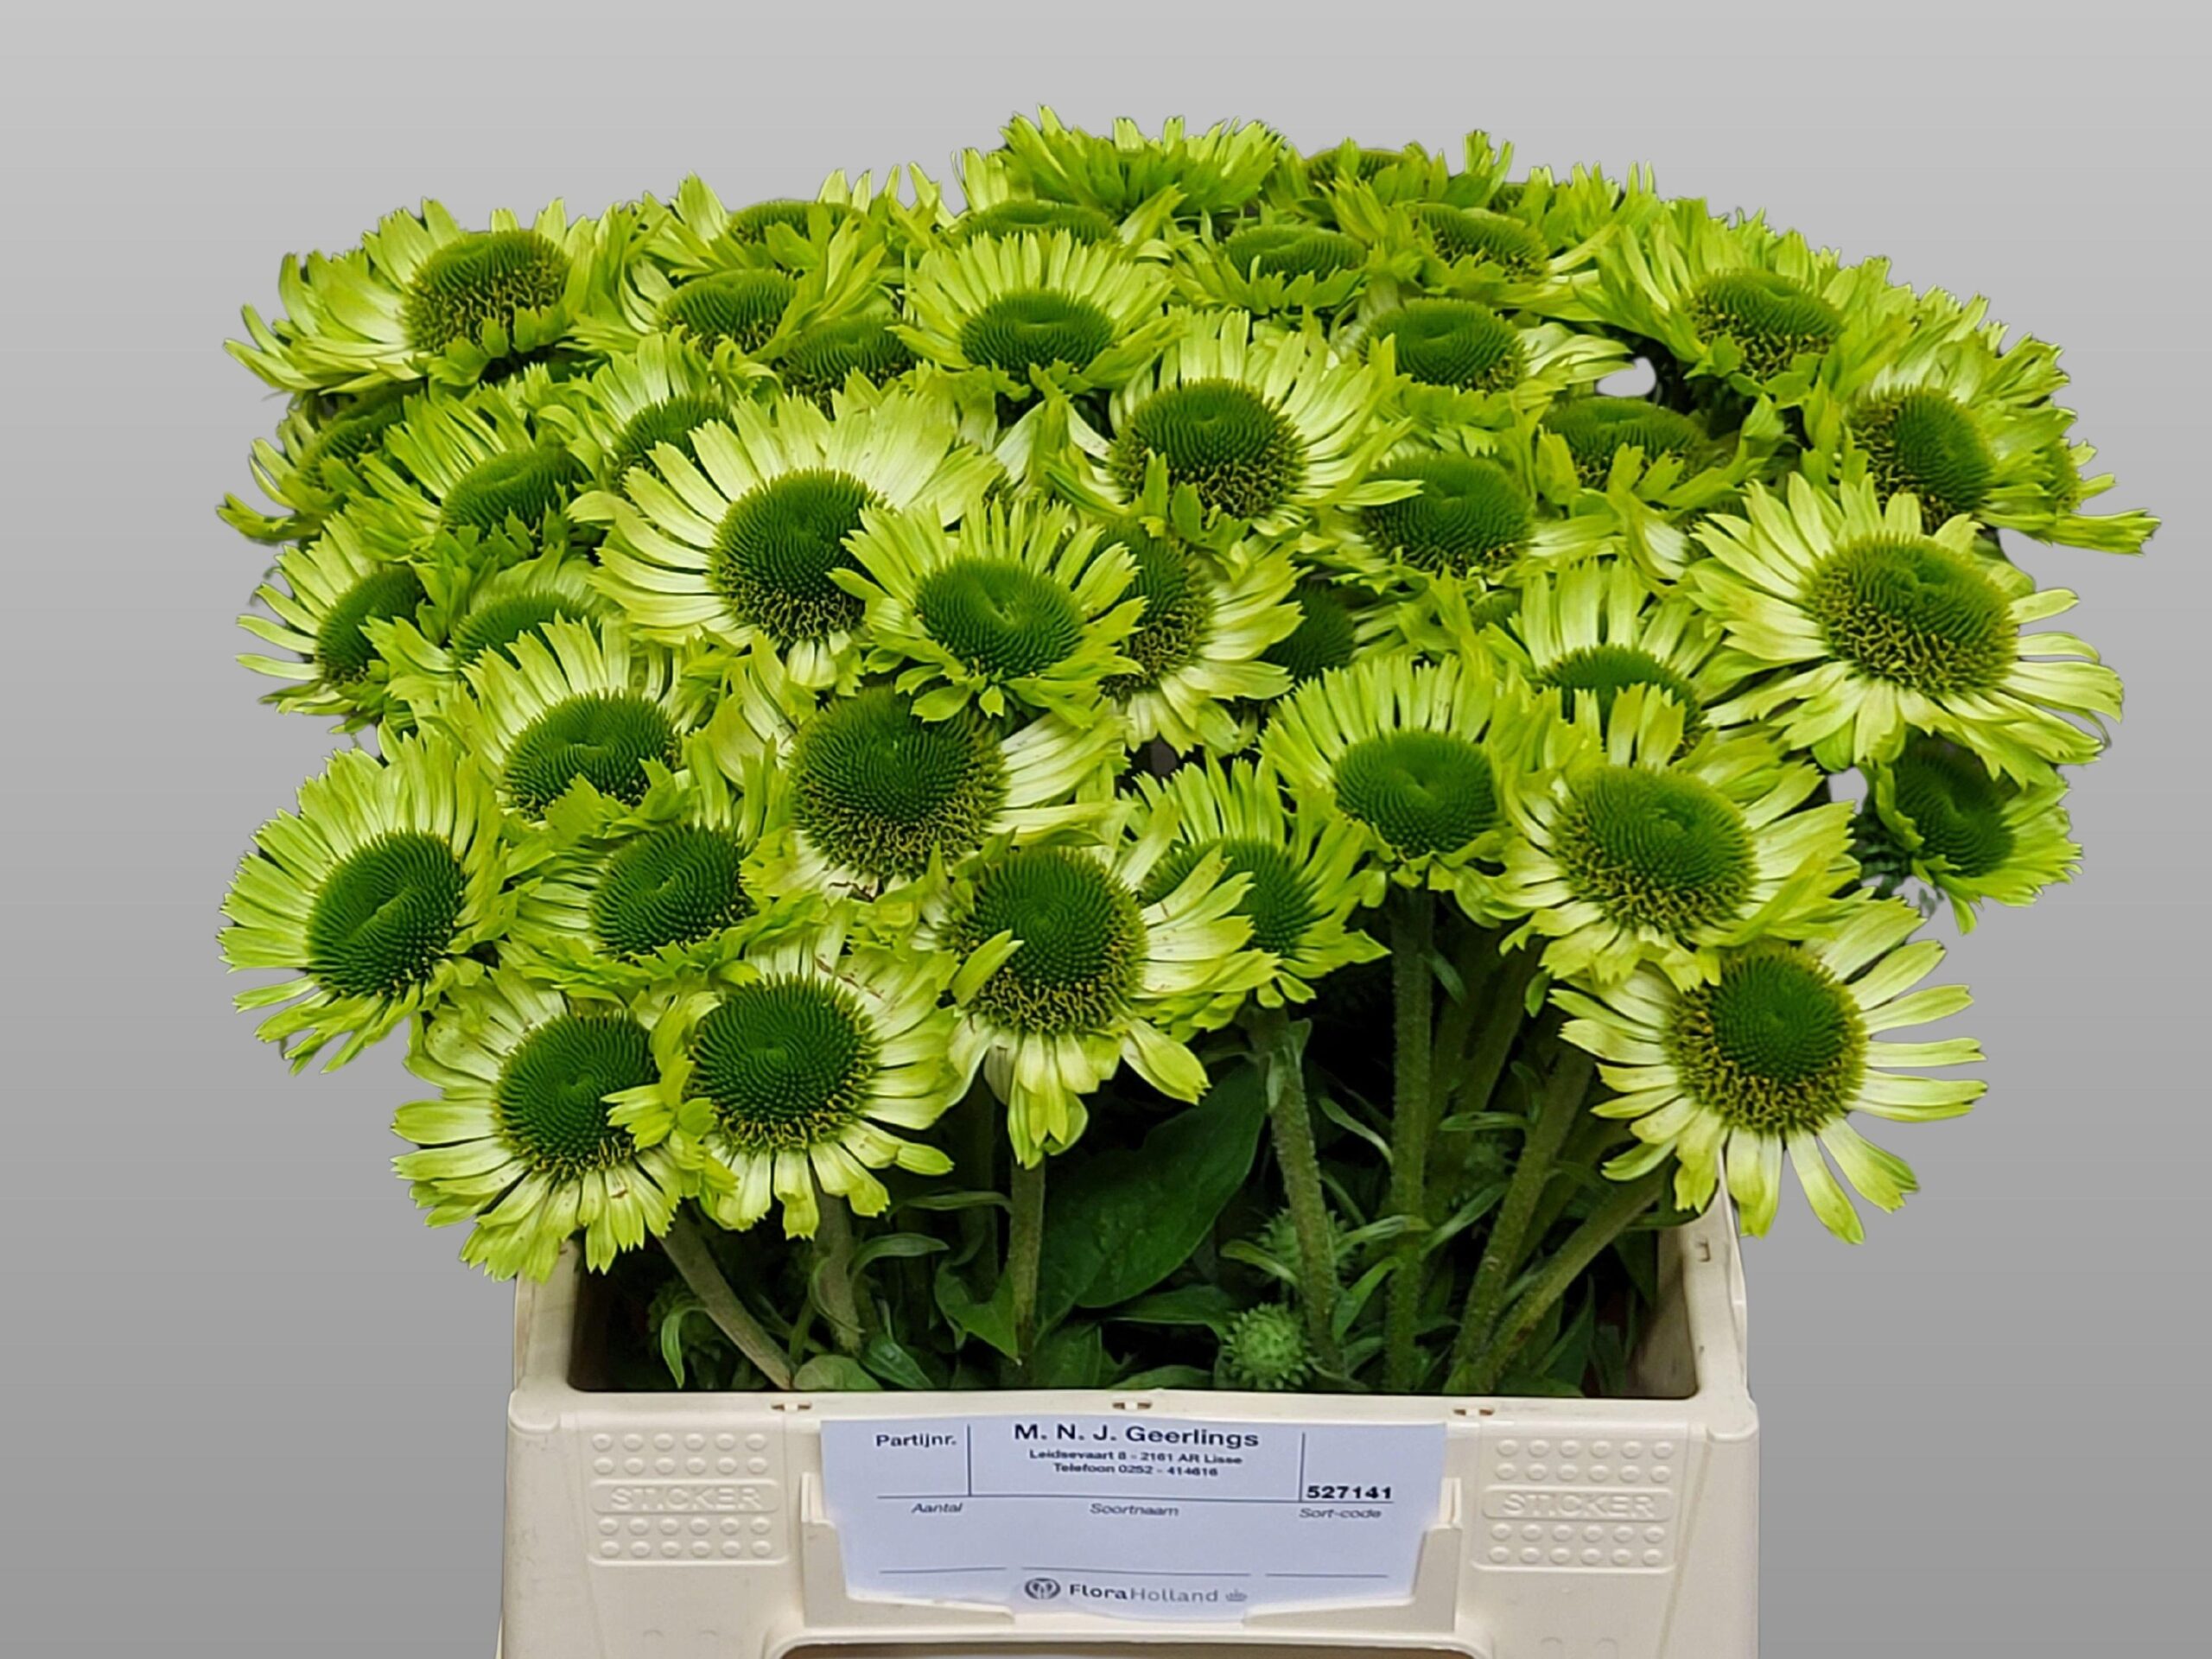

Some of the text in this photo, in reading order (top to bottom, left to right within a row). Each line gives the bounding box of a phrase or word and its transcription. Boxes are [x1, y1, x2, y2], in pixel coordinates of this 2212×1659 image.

[875, 1433, 957, 1448] Partijnr.
[1014, 1423, 1260, 1450] M. N. J. Geerlings
[1029, 1449, 1114, 1460] Leidsevaart
[1141, 1452, 1173, 1462] 2161
[1178, 1453, 1199, 1464] AR
[1204, 1453, 1243, 1465] Lisse
[1052, 1462, 1115, 1474] Telefoon
[1118, 1464, 1154, 1475] 0252
[610, 1486, 763, 1510] STICKER
[1306, 1485, 1393, 1500] 527141
[911, 1502, 963, 1514] Aantal
[1090, 1503, 1179, 1516] Soortnaam
[1503, 1492, 1656, 1518] STICKER
[1299, 1507, 1382, 1519] Sort-code
[1069, 1583, 1218, 1603] FloraHolland
